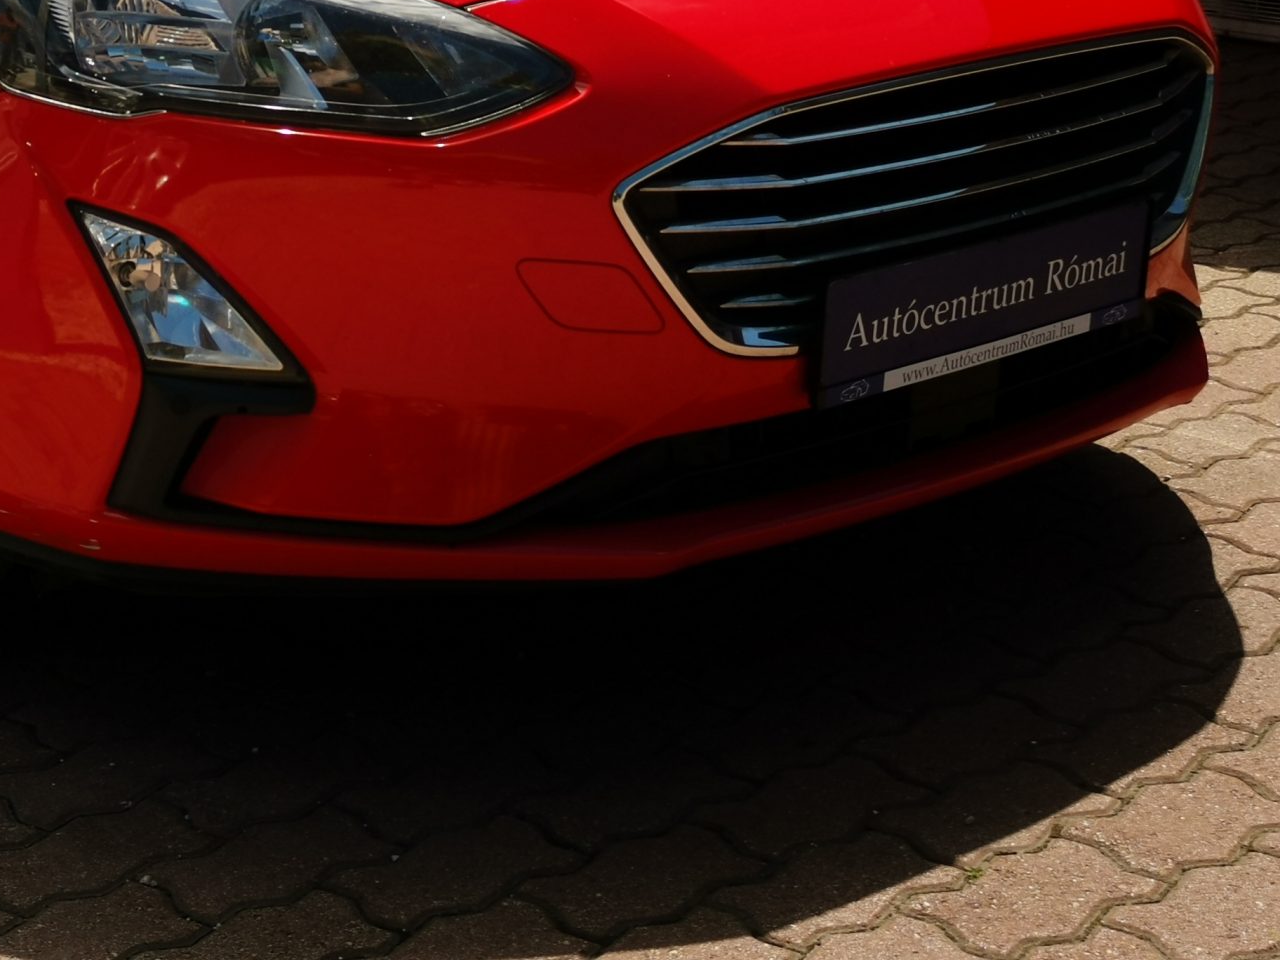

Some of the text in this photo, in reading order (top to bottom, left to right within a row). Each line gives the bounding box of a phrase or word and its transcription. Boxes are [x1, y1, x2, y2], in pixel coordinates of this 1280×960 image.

[843, 240, 1127, 352] Autócentrum Római
[901, 321, 1075, 383] www.AutócentrumRómai.hu
